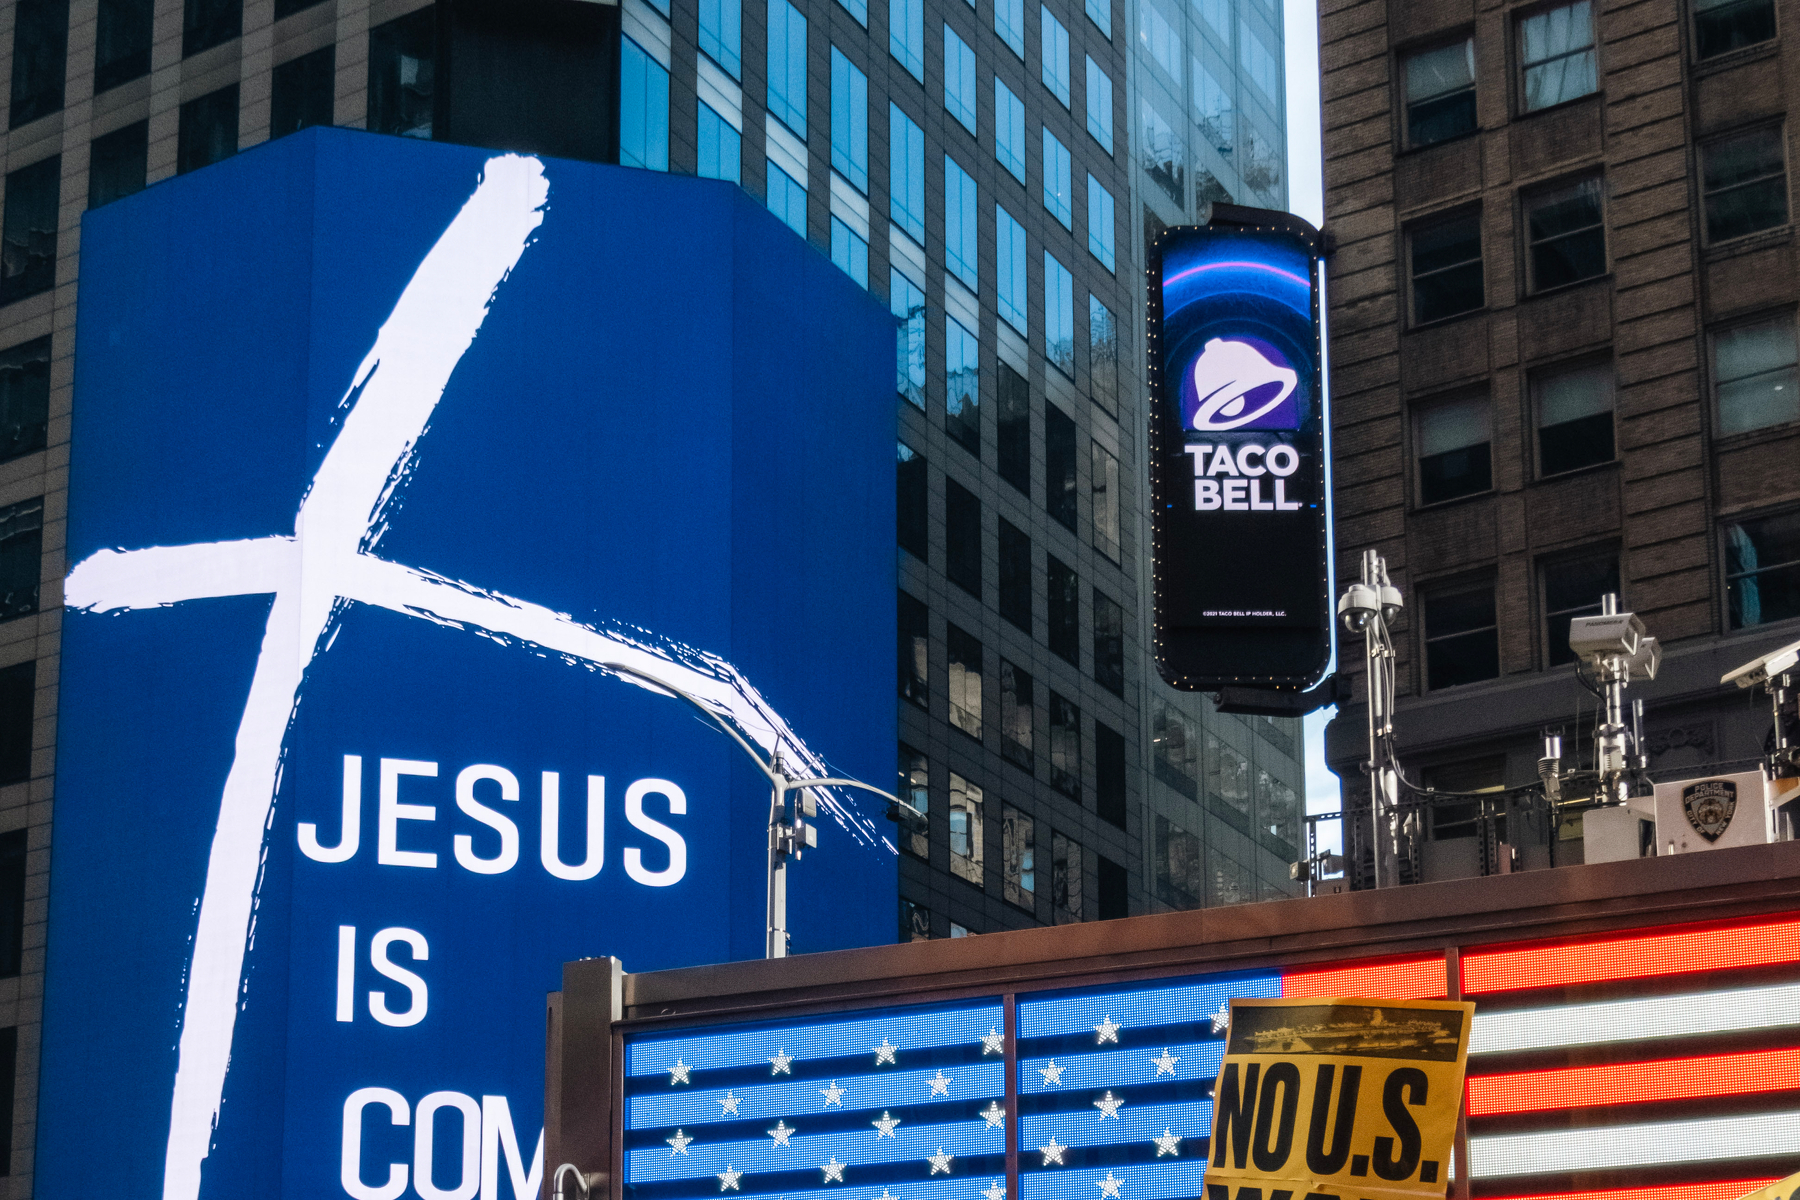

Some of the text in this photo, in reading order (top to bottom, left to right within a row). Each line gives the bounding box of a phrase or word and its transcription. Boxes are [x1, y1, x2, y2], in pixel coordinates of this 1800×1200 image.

[1184, 444, 1299, 477] TACO
[1194, 479, 1299, 511] BELL
[1685, 790, 1734, 804] DEPARTMENT
[1694, 782, 1724, 792] POLICE
[298, 755, 687, 887] JESUS
[1687, 810, 1698, 825] CITY
[336, 925, 429, 1028] IS
[1213, 1061, 1440, 1184] NO U.S.
